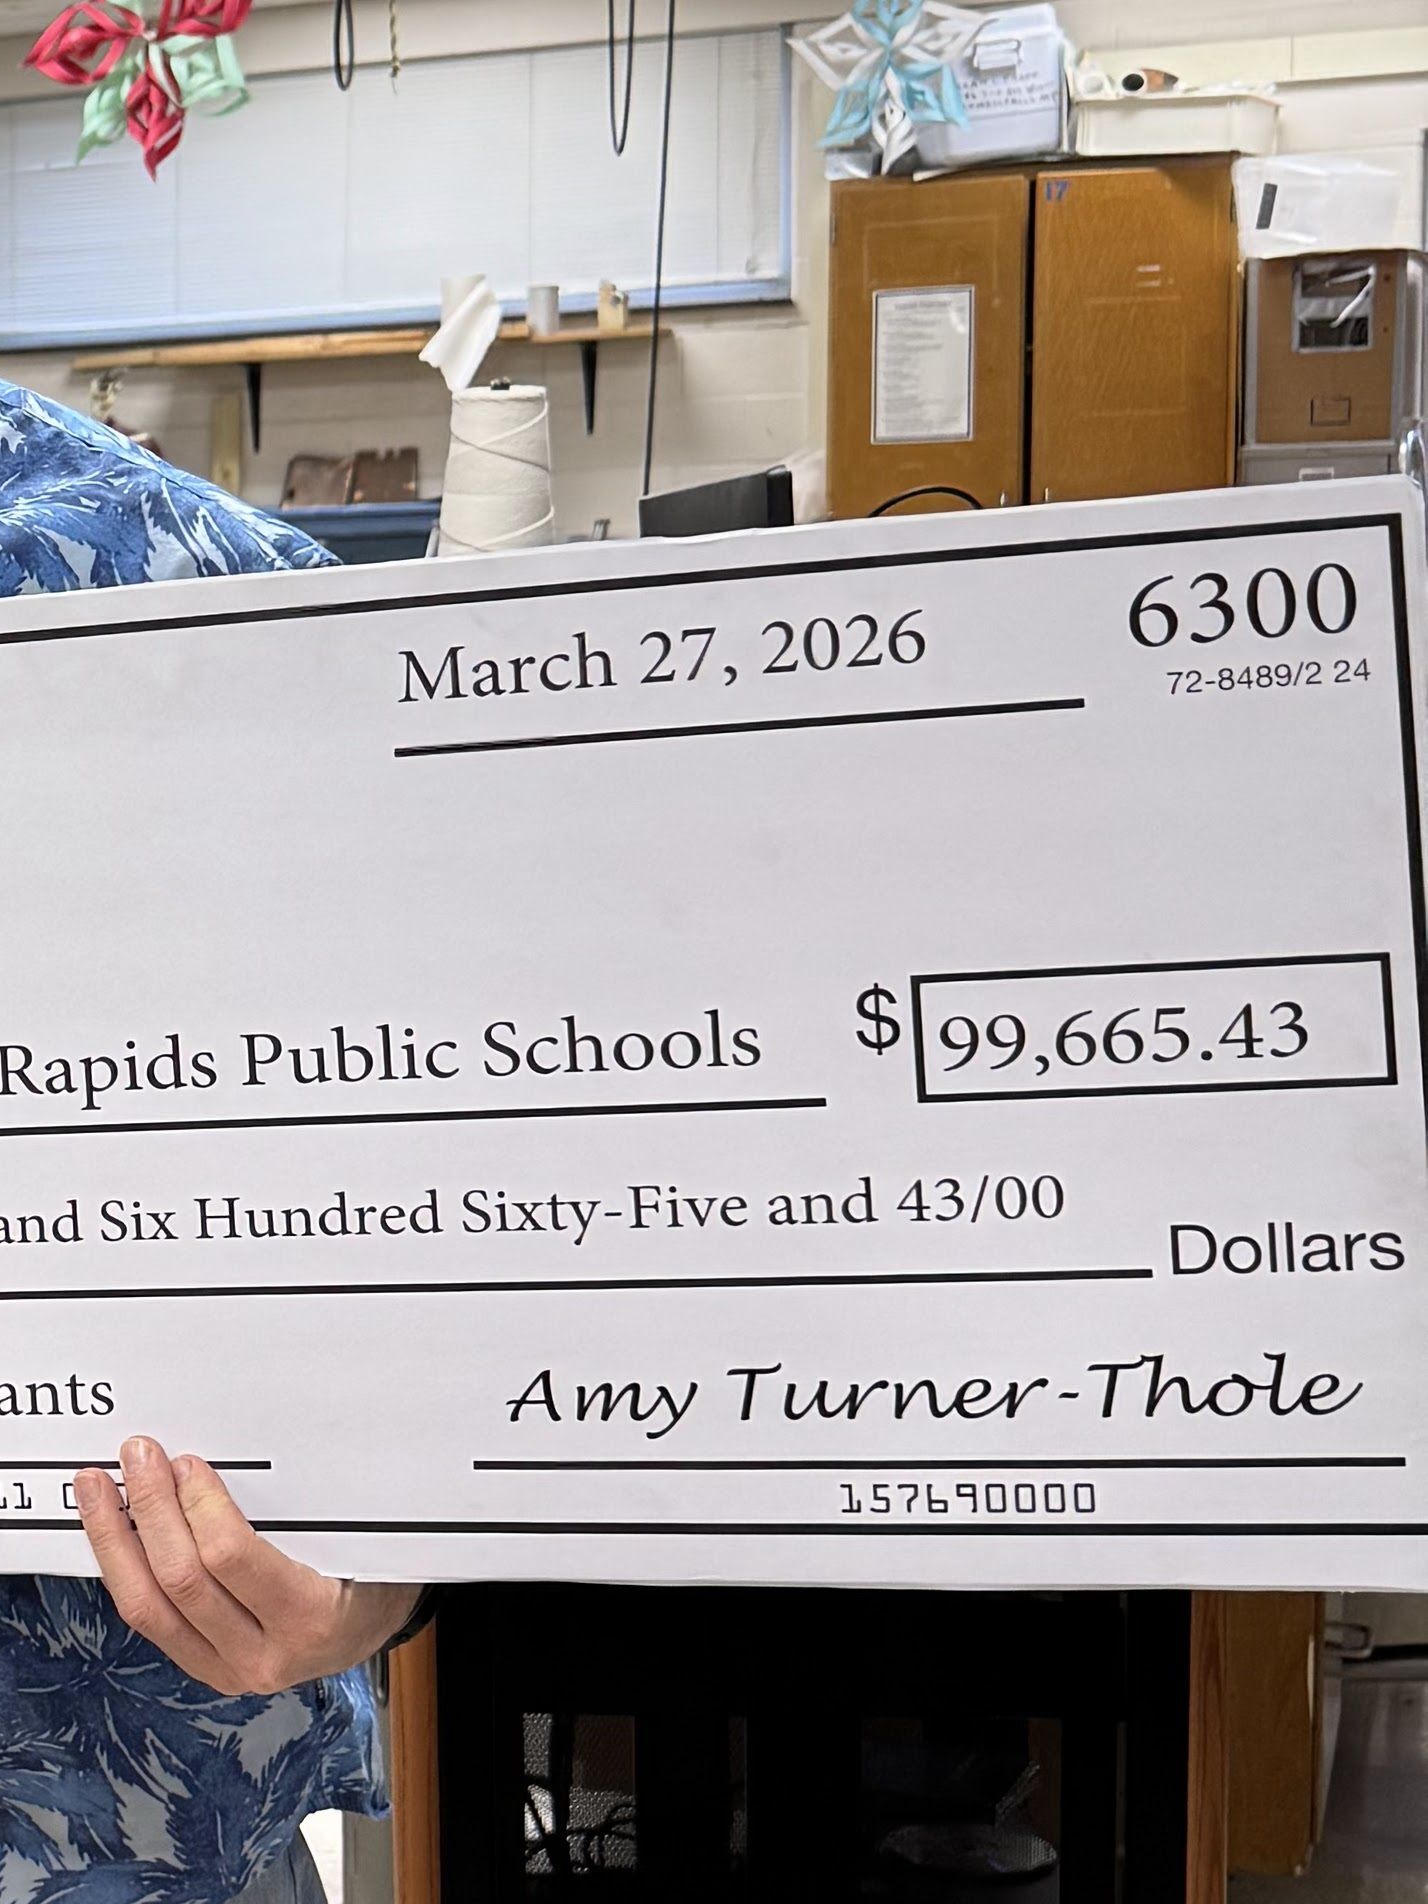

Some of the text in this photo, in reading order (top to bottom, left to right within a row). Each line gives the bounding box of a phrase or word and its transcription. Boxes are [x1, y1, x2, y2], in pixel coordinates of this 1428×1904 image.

[1129, 563, 1357, 648] 6300
[397, 609, 926, 703] March 27, 2026
[1166, 658, 1371, 695] 72-8489/2 24
[239, 1023, 460, 1086] Public
[483, 1008, 761, 1077] Schools
[855, 982, 1308, 1076] $ 99,665.43
[100, 1199, 179, 1242] Six
[193, 1188, 444, 1240] Hundred
[462, 1185, 748, 1246] Sixty-Five
[768, 1176, 879, 1226] and
[896, 1174, 1064, 1224] 43/00
[1170, 1221, 1405, 1275] Dollars
[505, 1352, 1364, 1440] Amy Turner-Thole
[839, 1482, 1096, 1514] 157690000
